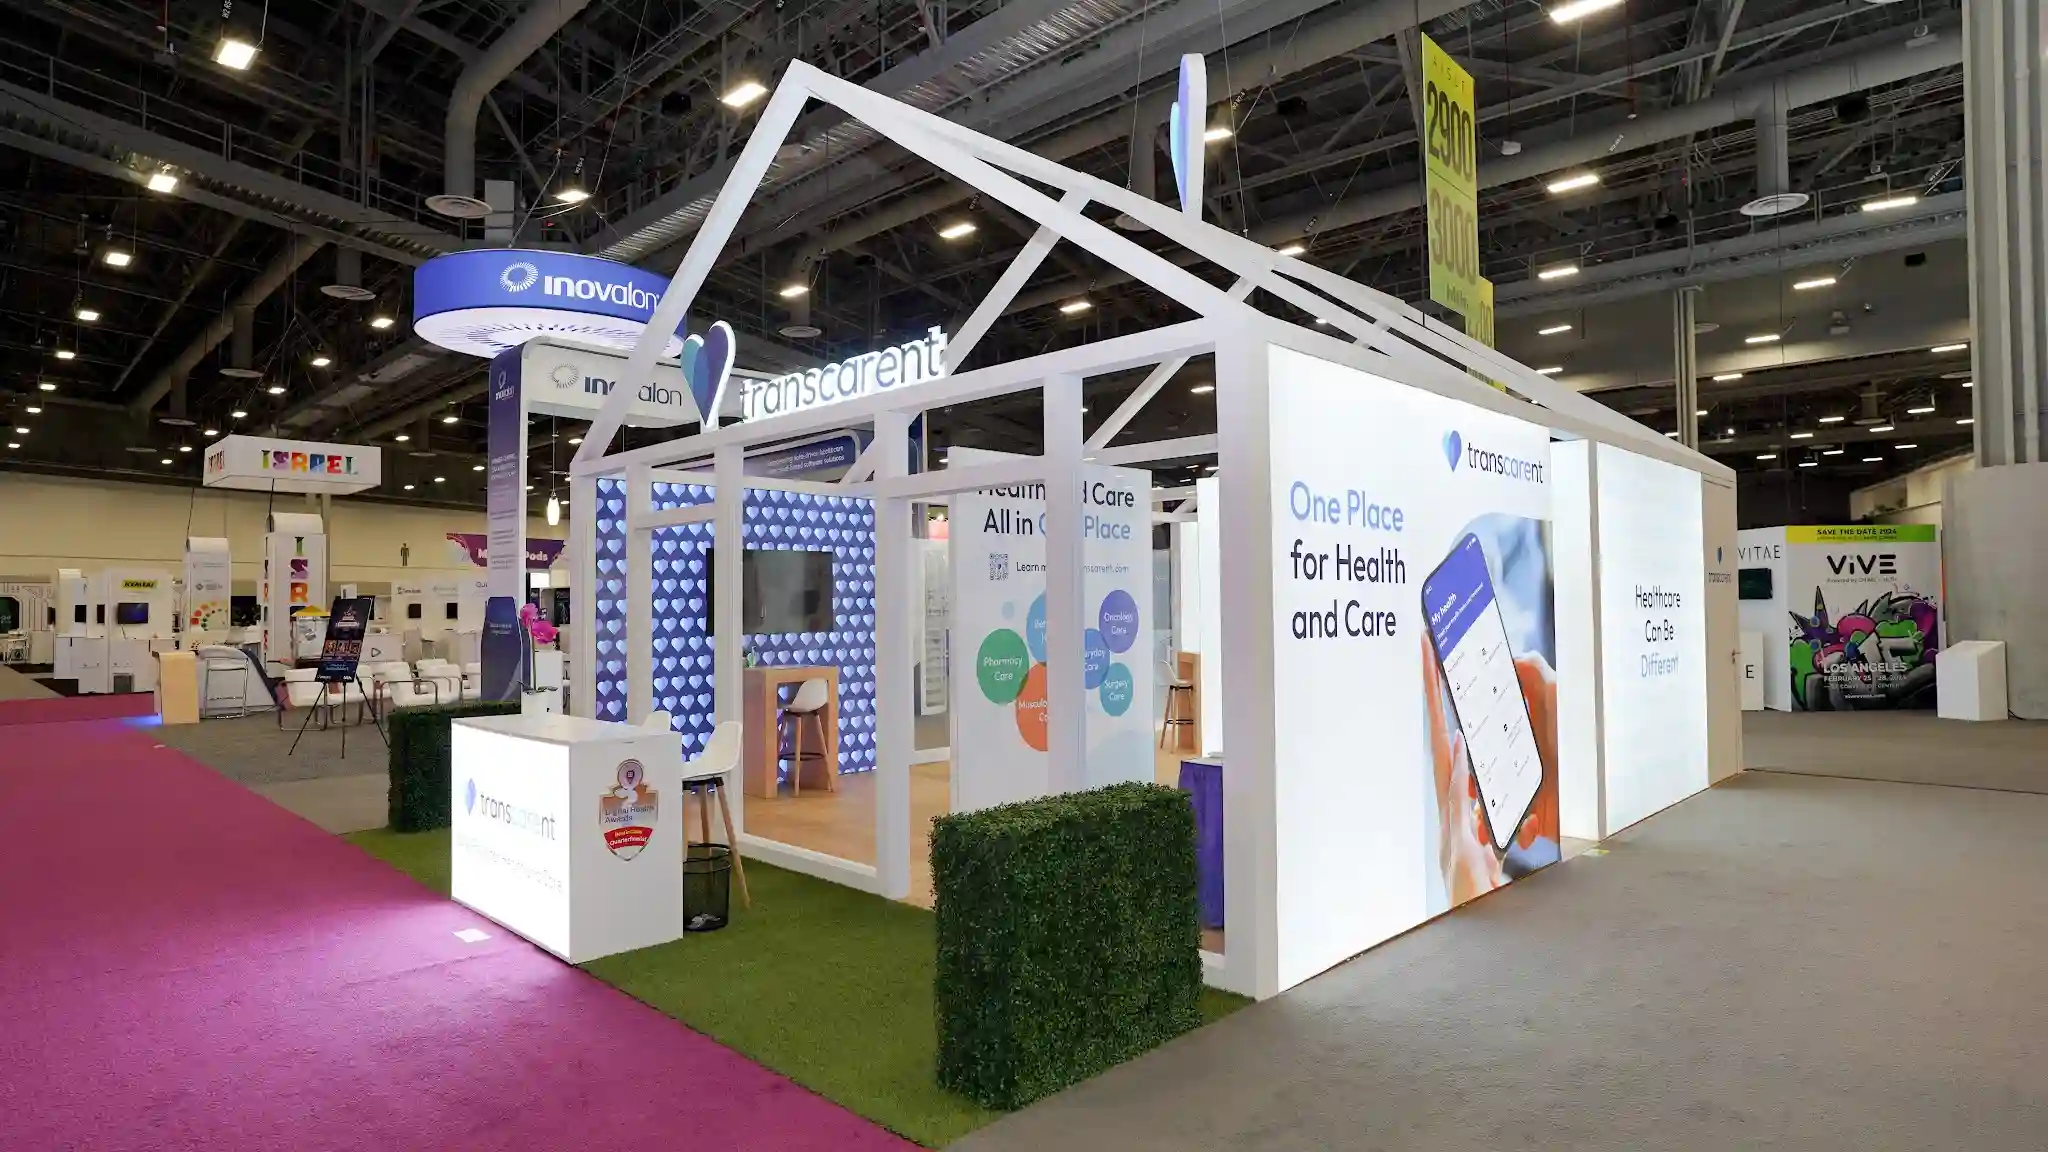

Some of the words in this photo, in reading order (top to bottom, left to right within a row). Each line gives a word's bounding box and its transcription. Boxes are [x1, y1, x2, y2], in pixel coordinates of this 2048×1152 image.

[1427, 80, 1474, 183] 2900
[1430, 187, 1477, 286] 3000
[544, 275, 658, 311] inovalon
[1467, 300, 1493, 348] 00
[739, 328, 944, 420] transcarent
[584, 376, 682, 407] inalon
[261, 449, 359, 475] ISRAEL
[1468, 442, 1544, 484] transcarent
[978, 483, 1047, 500] ealth
[1092, 482, 1135, 508] Care
[1290, 480, 1341, 524] One
[1347, 489, 1404, 532] Place
[983, 508, 1010, 535] All
[1016, 510, 1033, 536] in
[1084, 515, 1131, 540] Place
[1290, 538, 1329, 581] for
[1336, 543, 1406, 584] Health
[1737, 544, 1781, 562] VITAE
[1826, 553, 1897, 575] ViVE
[1017, 561, 1040, 573] Learn
[1084, 563, 1129, 574] nscarent.com
[1432, 611, 1440, 626] My
[1439, 592, 1456, 616] health
[1635, 584, 1681, 611] Healthcare
[1103, 612, 1134, 623] Oncology
[1110, 625, 1127, 635] Care
[1292, 598, 1338, 640] and
[1344, 599, 1397, 638] Care
[1645, 619, 1662, 643] Can
[1663, 618, 1674, 642] Be
[983, 656, 1023, 668] Pharmacy
[1641, 652, 1680, 678] Different
[1823, 663, 1848, 674] LOS
[1851, 662, 1909, 673] ANGELES
[993, 671, 1014, 682] Care
[1104, 679, 1129, 690] Surgery
[1108, 692, 1125, 701] Care
[604, 815, 633, 824] Awards
